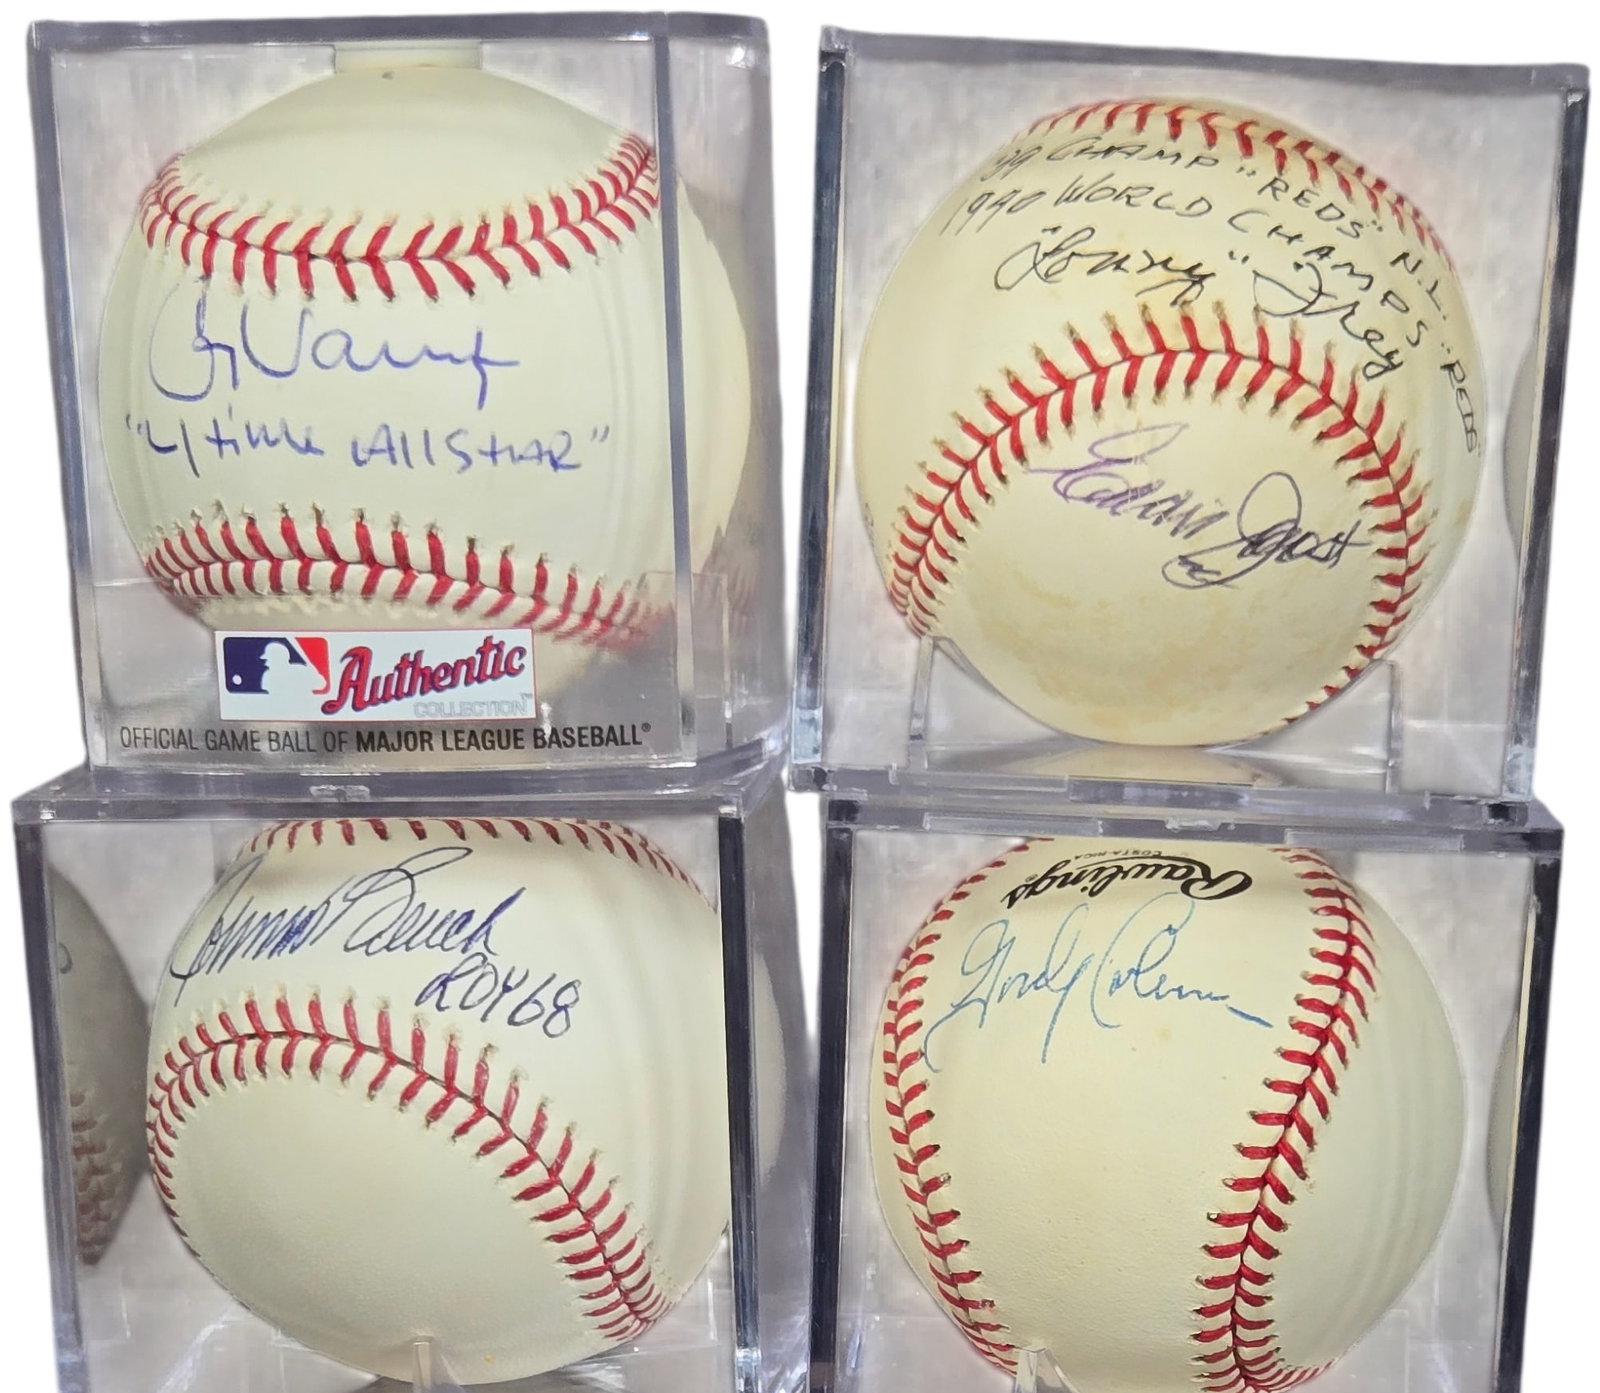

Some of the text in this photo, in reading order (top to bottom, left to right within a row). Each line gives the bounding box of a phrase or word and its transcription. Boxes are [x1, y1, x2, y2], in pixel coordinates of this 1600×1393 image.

[1053, 172, 1213, 217] WORLD
[320, 634, 527, 716] Authentic
[412, 699, 527, 719] COLLECTION
[119, 723, 643, 753] OFFICIAL GAME BALL OF MAJOR LEAGUE BASEBALL
[1000, 855, 1252, 909] Rawlings
